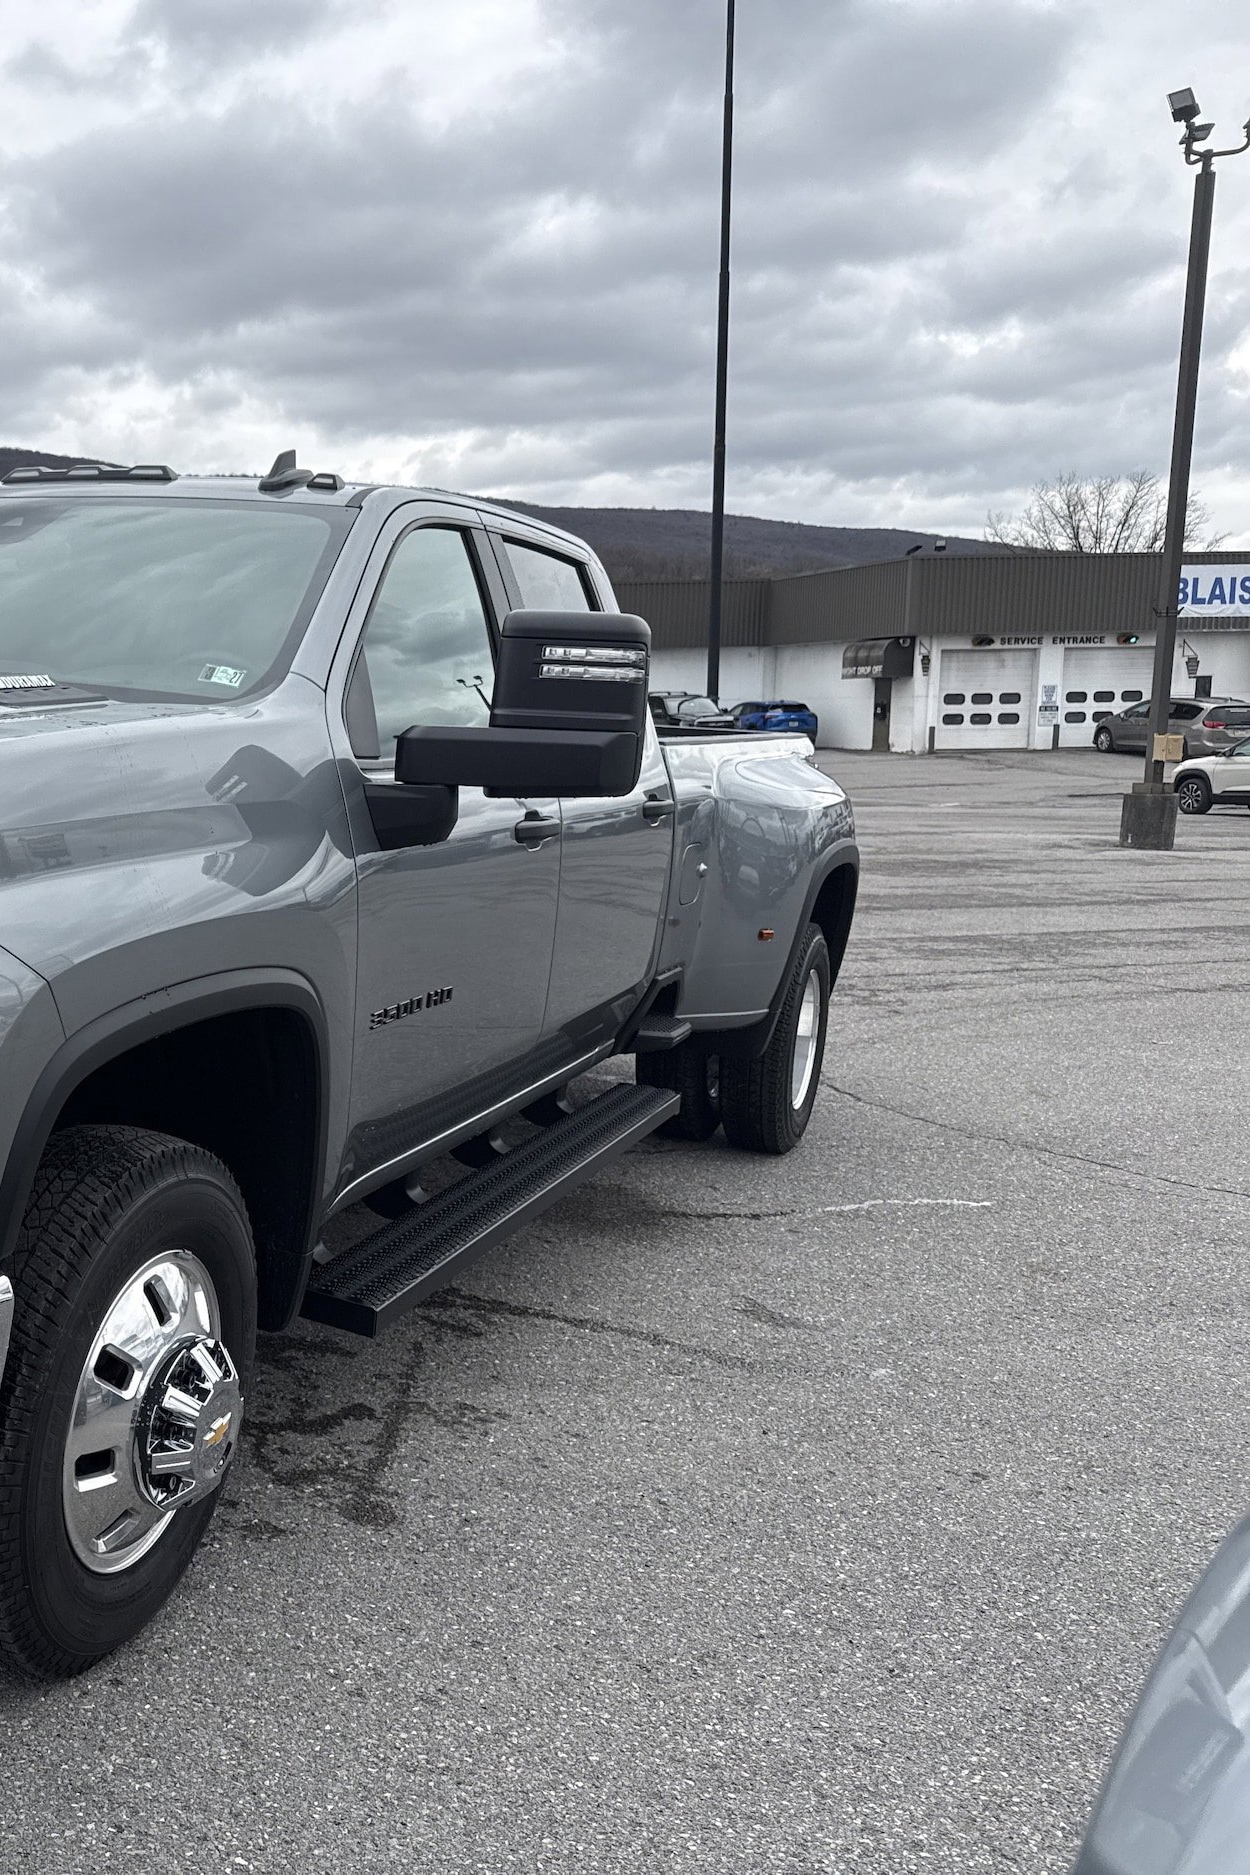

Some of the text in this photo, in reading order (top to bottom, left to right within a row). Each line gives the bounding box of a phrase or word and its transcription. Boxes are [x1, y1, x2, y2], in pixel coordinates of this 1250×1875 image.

[1000, 636, 1106, 646] SERVICE ENTRANCE
[857, 666, 871, 675] DROP
[872, 664, 883, 674] OFF
[0, 674, 56, 689] DURAMAX
[229, 671, 243, 684] 27
[369, 986, 453, 1030] 3500 HD
